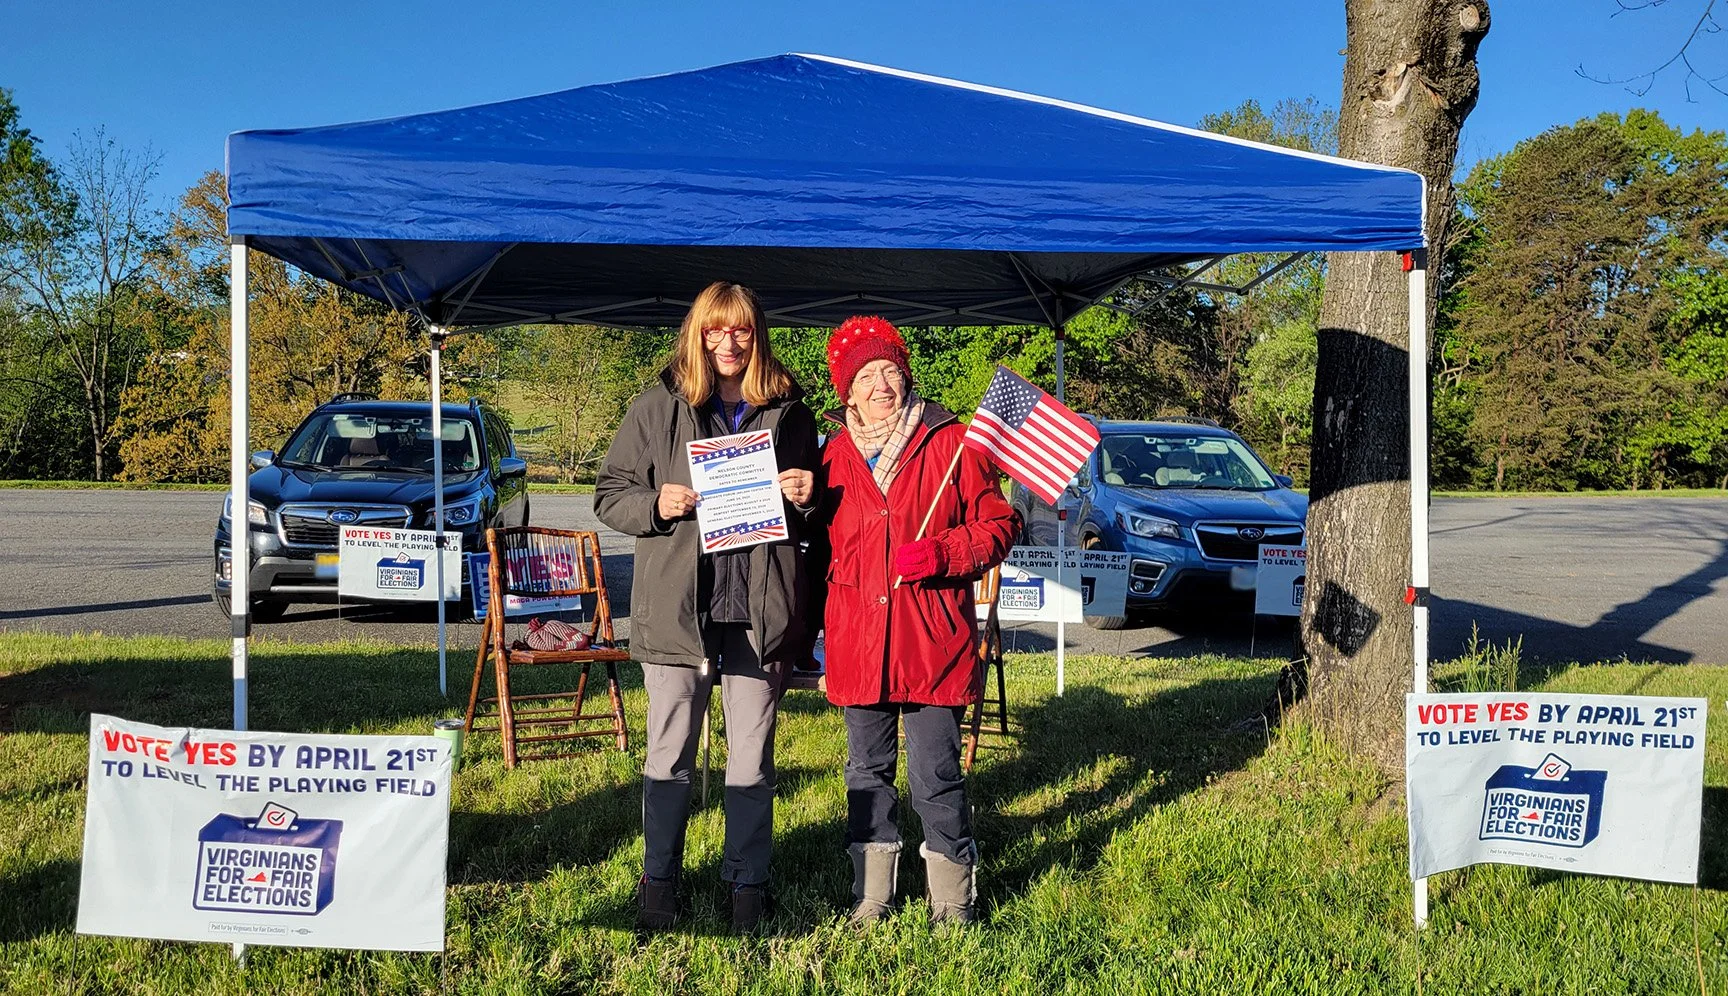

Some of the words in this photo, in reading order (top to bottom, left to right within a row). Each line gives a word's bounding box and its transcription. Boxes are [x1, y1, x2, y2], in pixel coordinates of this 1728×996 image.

[709, 472, 738, 480] DEMOCRATIC
[344, 530, 370, 539] VOTE
[373, 531, 392, 540] YES
[394, 533, 408, 541] BY
[410, 533, 437, 543] APRIL
[1012, 550, 1025, 559] BY
[1028, 551, 1055, 559] APRIL
[1084, 553, 1108, 562] APRIL
[1112, 554, 1128, 563] 21ST
[1263, 548, 1287, 558] VOTE
[380, 568, 418, 576] VIRGINIANS
[1020, 560, 1052, 568] PLAYING
[380, 580, 418, 588] ELECTIONS
[1002, 600, 1038, 608] ELECTIONS
[1417, 703, 1479, 725] VOTE
[1486, 702, 1530, 722] YES
[1538, 704, 1571, 724] BY
[1577, 705, 1646, 727] APRIL
[1653, 706, 1698, 728] 21ST
[1417, 731, 1441, 747] TO
[1448, 729, 1501, 746] LEVEL
[1508, 728, 1547, 744] THE
[1552, 730, 1634, 747] PLAYING
[1641, 734, 1695, 750] FIELD
[103, 729, 172, 763] VOTE
[184, 742, 237, 766] YES
[248, 744, 286, 769] BY
[296, 745, 376, 771] APRIL
[386, 748, 438, 772] 21ST
[102, 759, 134, 778] TO
[142, 762, 207, 790] LEVEL
[216, 774, 260, 792] THE
[268, 776, 368, 794] PLAYING
[376, 778, 436, 798] FIELD
[1490, 792, 1586, 814] VIRGINIANS
[1488, 806, 1520, 822] FOR
[1542, 810, 1583, 828] FAIR
[1485, 820, 1581, 842] ELECTIONS
[206, 847, 318, 872] VIRGINIANS
[205, 866, 244, 885] FOR
[270, 870, 314, 890] FAIR
[203, 884, 312, 908] ELECTIONS
[267, 926, 286, 934] Elections
